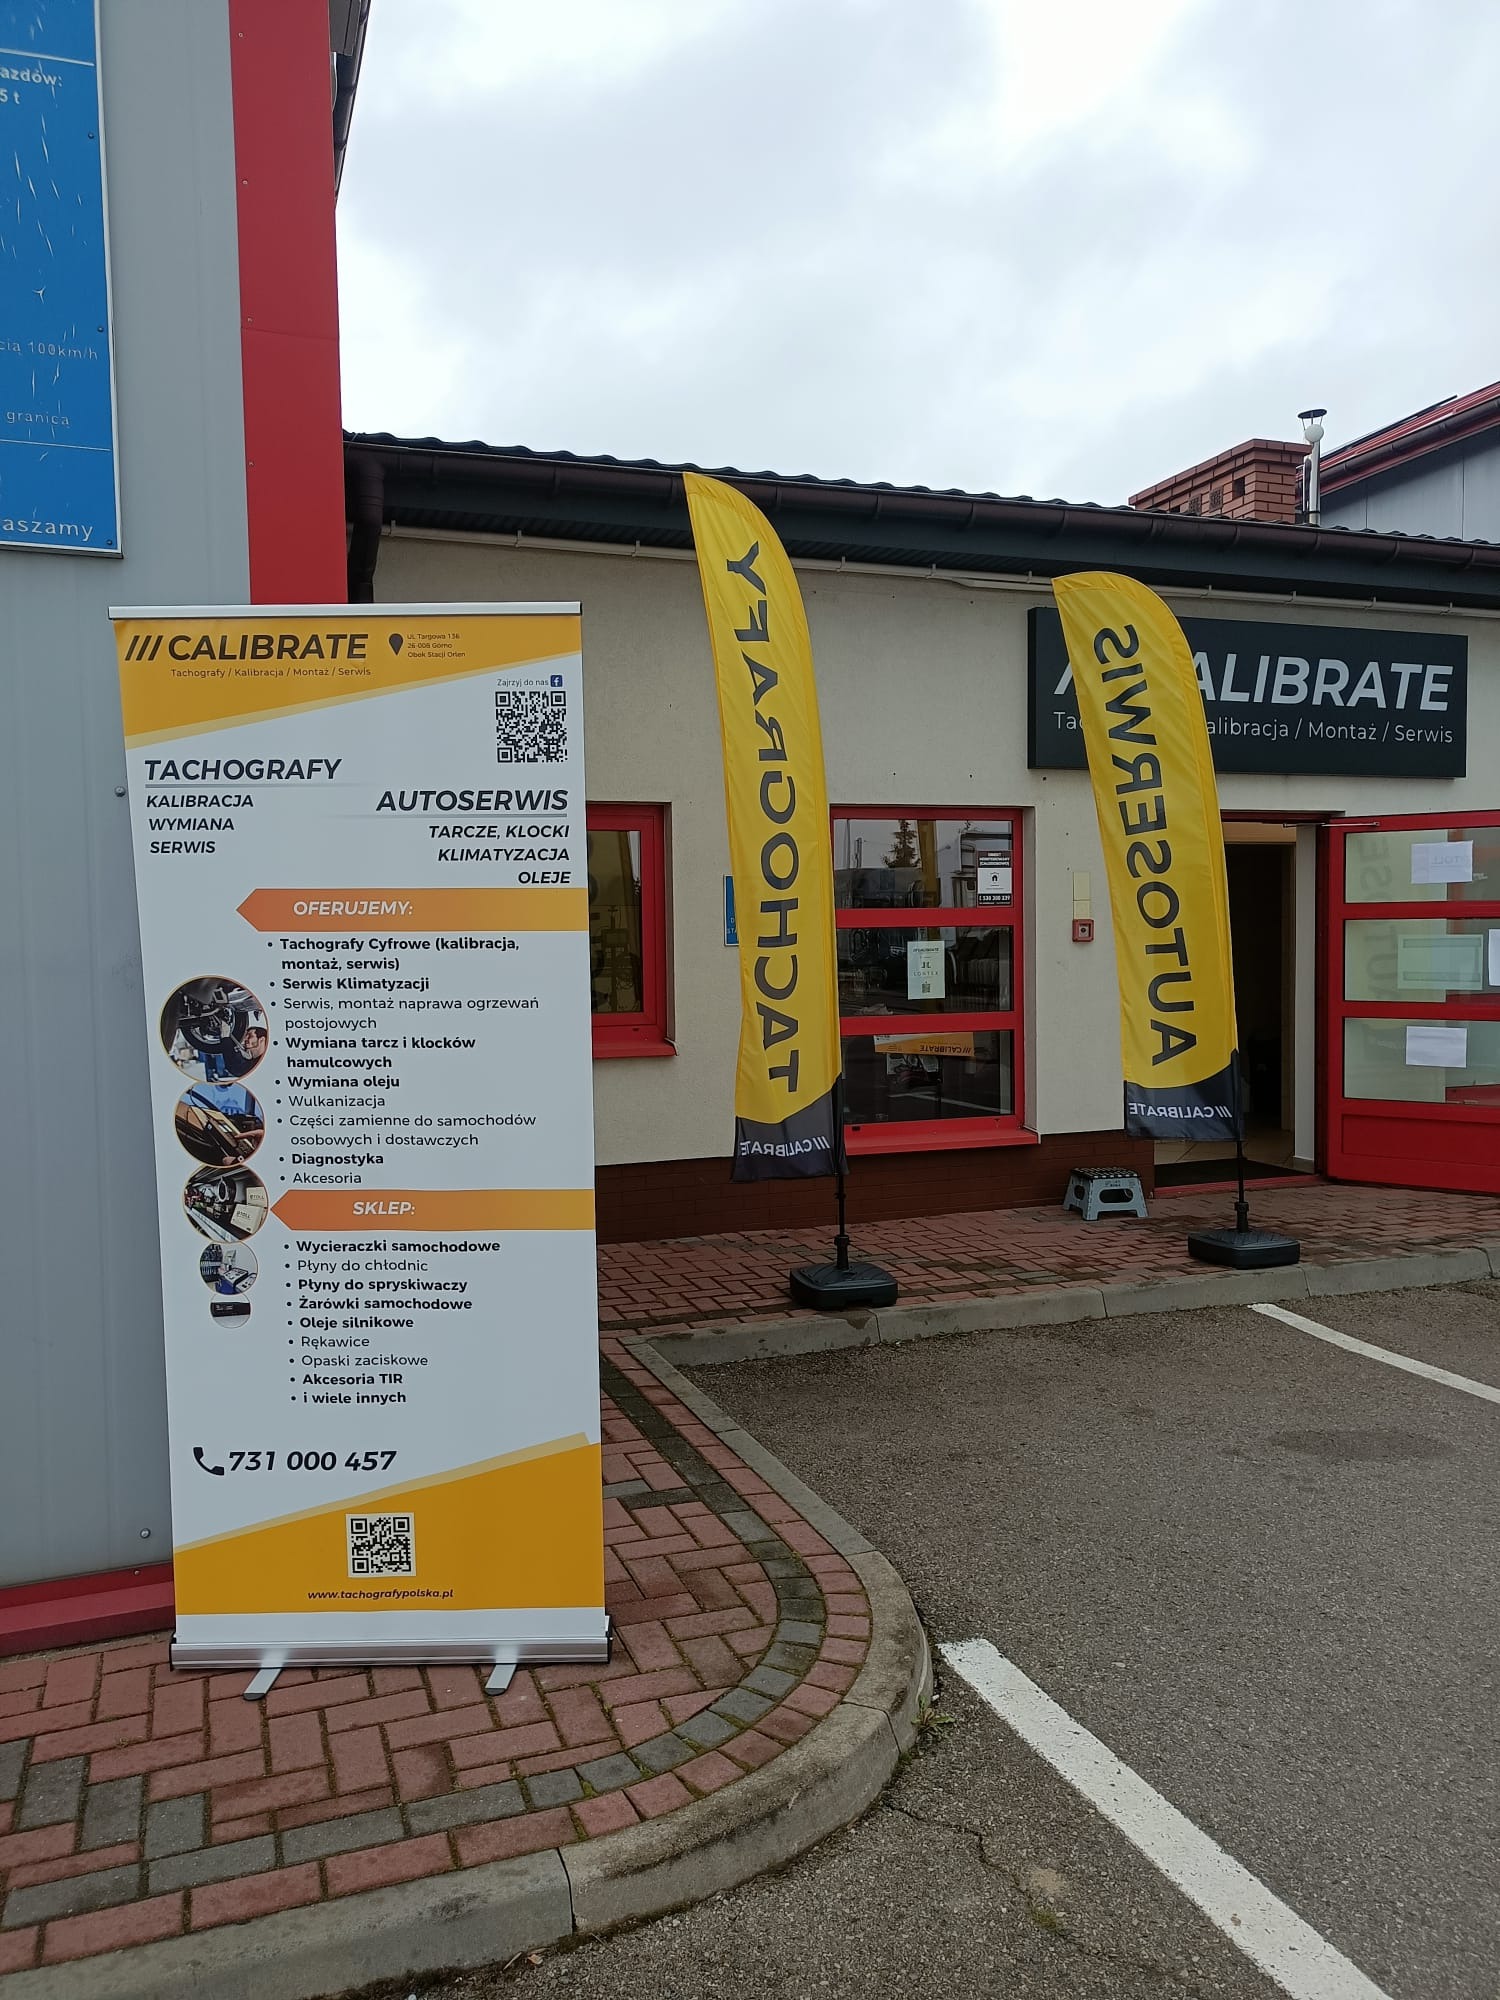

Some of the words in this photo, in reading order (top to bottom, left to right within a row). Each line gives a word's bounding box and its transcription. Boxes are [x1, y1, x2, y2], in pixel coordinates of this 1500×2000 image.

[0, 67, 63, 87] azdów:
[13, 91, 20, 105] t
[28, 340, 98, 360] 100km/h
[2, 519, 93, 542] aszamy
[427, 651, 446, 660] Stacji
[170, 669, 226, 679] Tachografy
[234, 668, 284, 679] Kalibracja
[293, 669, 329, 677] Montaż
[338, 667, 371, 676] Serwis
[497, 679, 522, 688] Zajrzyj
[1191, 651, 1454, 712] ALIBRATE
[1206, 716, 1290, 740] alibracja
[1309, 722, 1377, 741] Montaż
[1394, 725, 1453, 744] Serwis
[144, 759, 343, 781] TACHOGRAFY
[146, 795, 254, 808] KALIBRACJA
[376, 790, 569, 812] AUTOSERWIS
[148, 818, 235, 831] WYMIANA
[429, 826, 501, 840] TARCZE,
[505, 825, 570, 838] KLOCKI
[149, 841, 216, 854] SERWIS
[438, 849, 570, 862] KLIMATYZACJA
[518, 872, 572, 884] OLEJE
[293, 901, 413, 916] OFERUJEMY:
[280, 938, 365, 953] Tachografy
[368, 938, 431, 953] Cyfrowe
[435, 937, 519, 952] (kalibracja,
[281, 958, 342, 972] montaż,
[346, 957, 400, 972] serwis)
[282, 978, 333, 990] Serwis
[336, 977, 430, 993] Klimatyzacji
[283, 998, 334, 1011] Serwis,
[338, 997, 395, 1009] montaż
[398, 1000, 463, 1013] naprawa
[467, 997, 539, 1012] ogrzewań
[285, 1017, 377, 1032] postojowych
[285, 1037, 357, 1052] Wymiana
[361, 1038, 399, 1049] tarcz
[411, 1037, 476, 1049] klocków
[287, 1056, 392, 1071] hamulcowych
[287, 1076, 359, 1090] Wymiana
[363, 1075, 400, 1090] oleju
[288, 1095, 386, 1109] Wulkanizacja
[289, 1115, 334, 1129] Części
[338, 1114, 410, 1127] zamienne
[414, 1115, 433, 1127] do
[437, 1114, 537, 1127] samochodów
[290, 1134, 373, 1148] osobowych
[385, 1134, 479, 1149] dostawczych
[291, 1153, 384, 1168] Diagnostyka
[292, 1172, 362, 1184] Akcesoria
[352, 1202, 416, 1216] SKLEP:
[296, 1240, 387, 1255] Wycieraczki
[391, 1241, 501, 1253] samochodowe
[297, 1260, 337, 1274] Płyny
[341, 1260, 361, 1272] do
[364, 1259, 428, 1272] chłodnic
[298, 1279, 341, 1293] Płyny
[344, 1279, 364, 1290] do
[368, 1279, 468, 1293] spryskiwaczy
[299, 1295, 360, 1310] Żarówki
[364, 1298, 473, 1310] samochodowe
[300, 1317, 338, 1331] Oleje
[342, 1316, 414, 1329] silnikowe
[301, 1336, 370, 1350] Rękawice
[301, 1355, 350, 1369] Opaski
[355, 1354, 429, 1366] zaciskowe
[302, 1373, 375, 1385] Akcesoria
[379, 1374, 403, 1384] TIR
[311, 1392, 352, 1404] wiele
[356, 1392, 407, 1406] innych
[228, 1451, 276, 1472] 731
[287, 1451, 337, 1471] 000
[344, 1451, 398, 1472] 457
[308, 1589, 454, 1601] www.tachografypolska.pl
